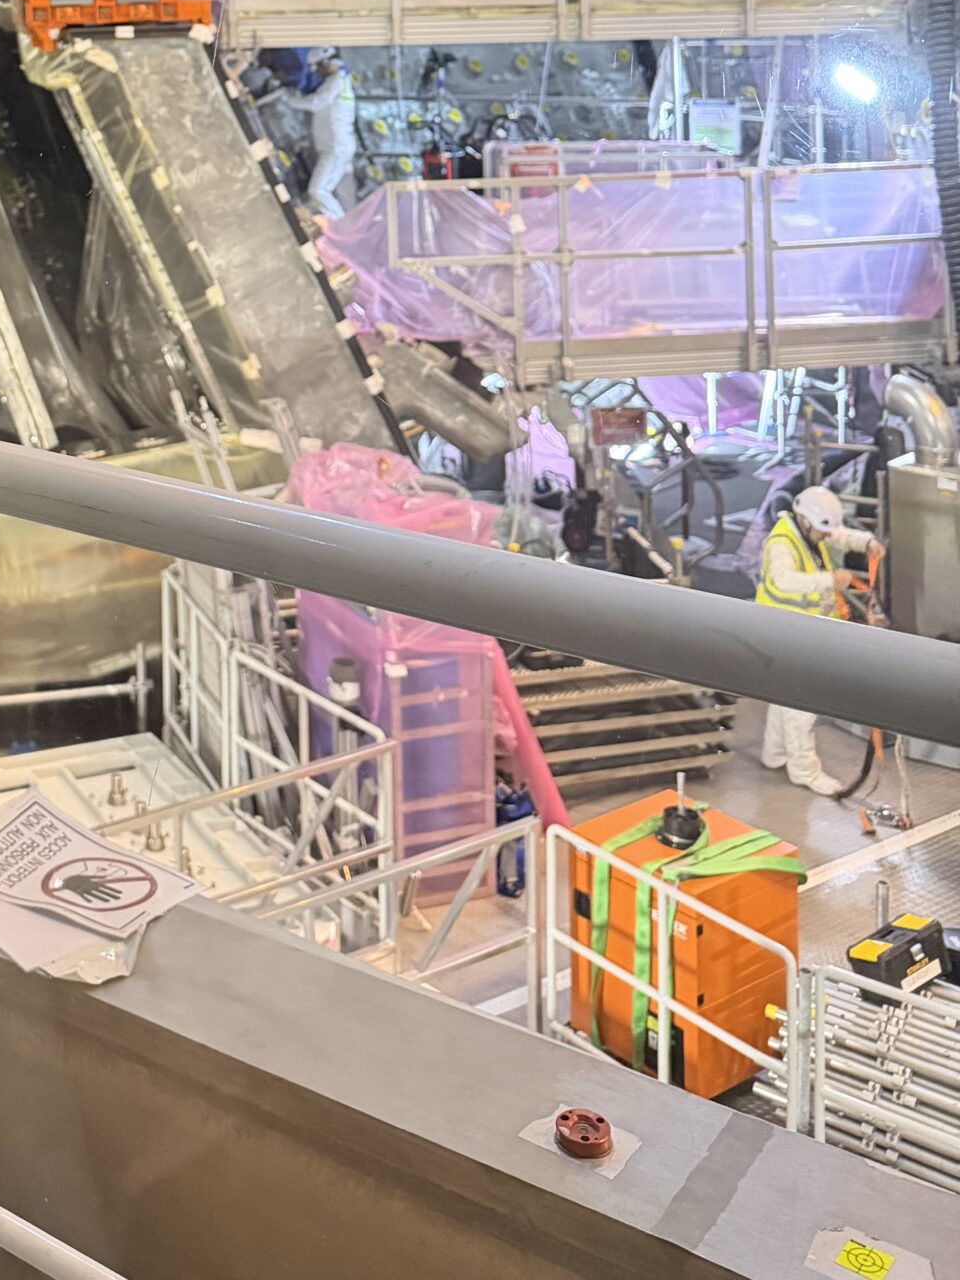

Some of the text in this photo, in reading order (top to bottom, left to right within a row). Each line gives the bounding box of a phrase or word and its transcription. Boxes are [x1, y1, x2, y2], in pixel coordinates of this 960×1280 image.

[19, 808, 48, 831] NON
[34, 820, 60, 841] AUX
[37, 831, 72, 860] ACCES
